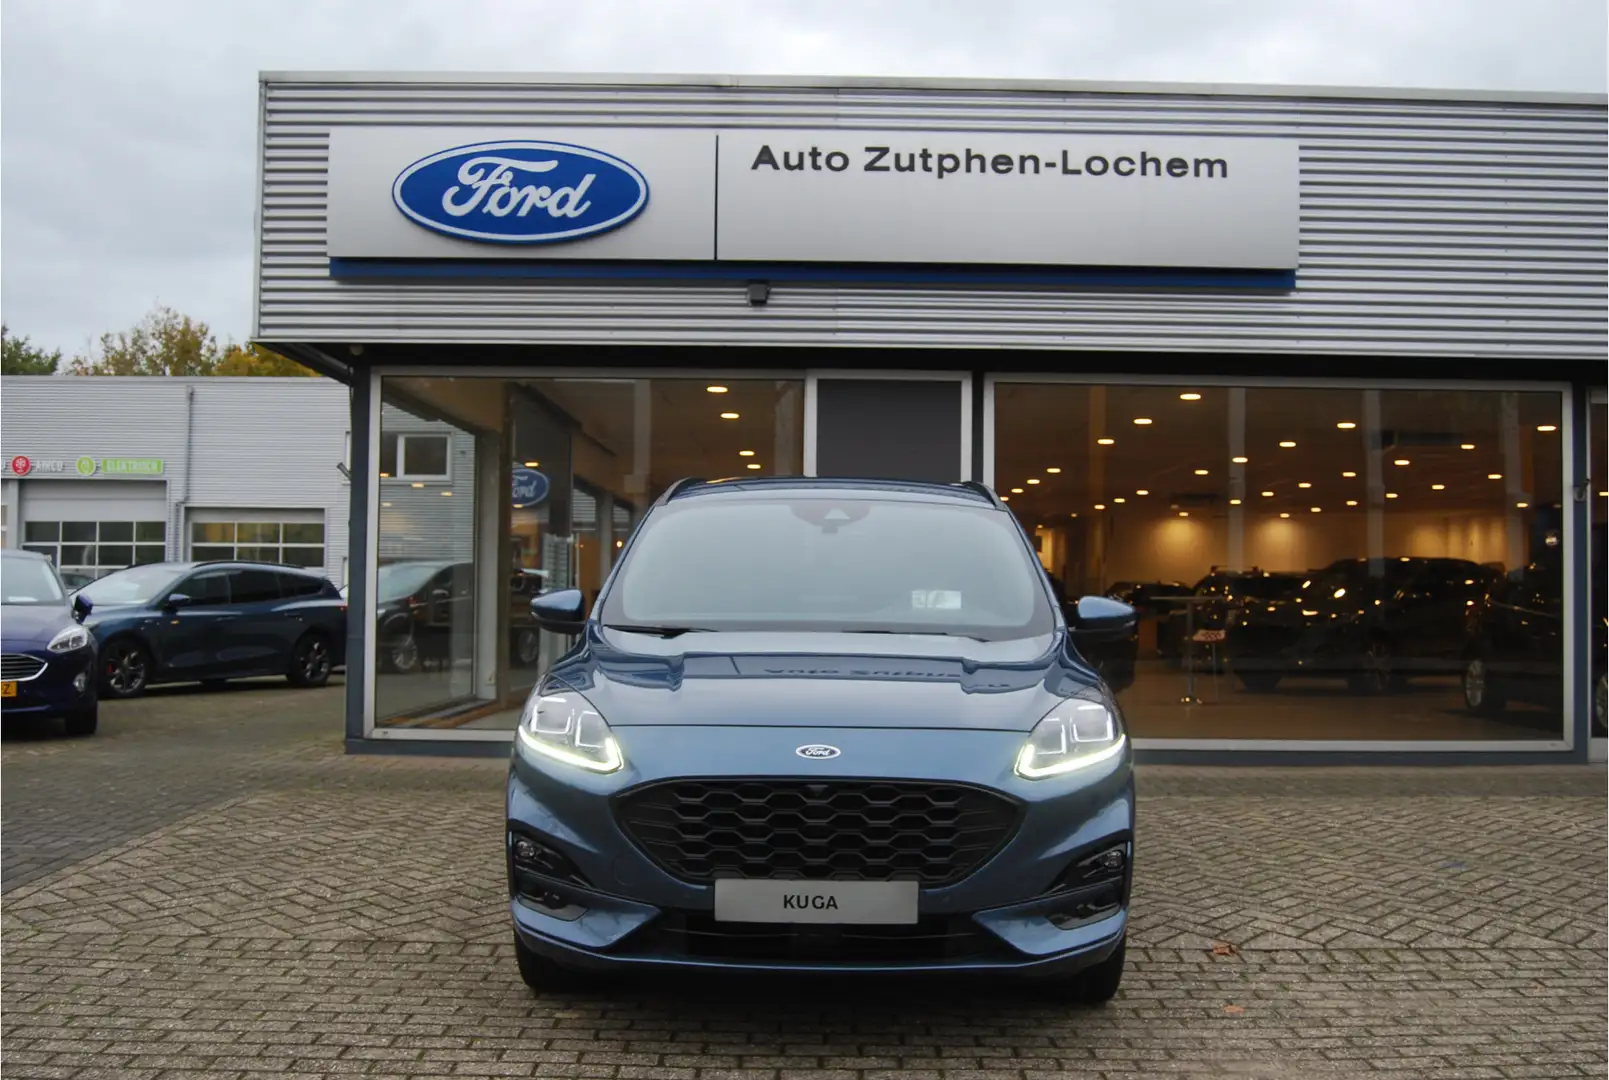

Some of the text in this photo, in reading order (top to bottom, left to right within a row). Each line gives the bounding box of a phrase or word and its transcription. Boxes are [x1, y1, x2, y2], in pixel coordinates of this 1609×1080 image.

[751, 145, 1228, 179] Auto Zutphen-Lochem
[441, 156, 597, 218] Ford
[783, 894, 839, 910] KUGA
